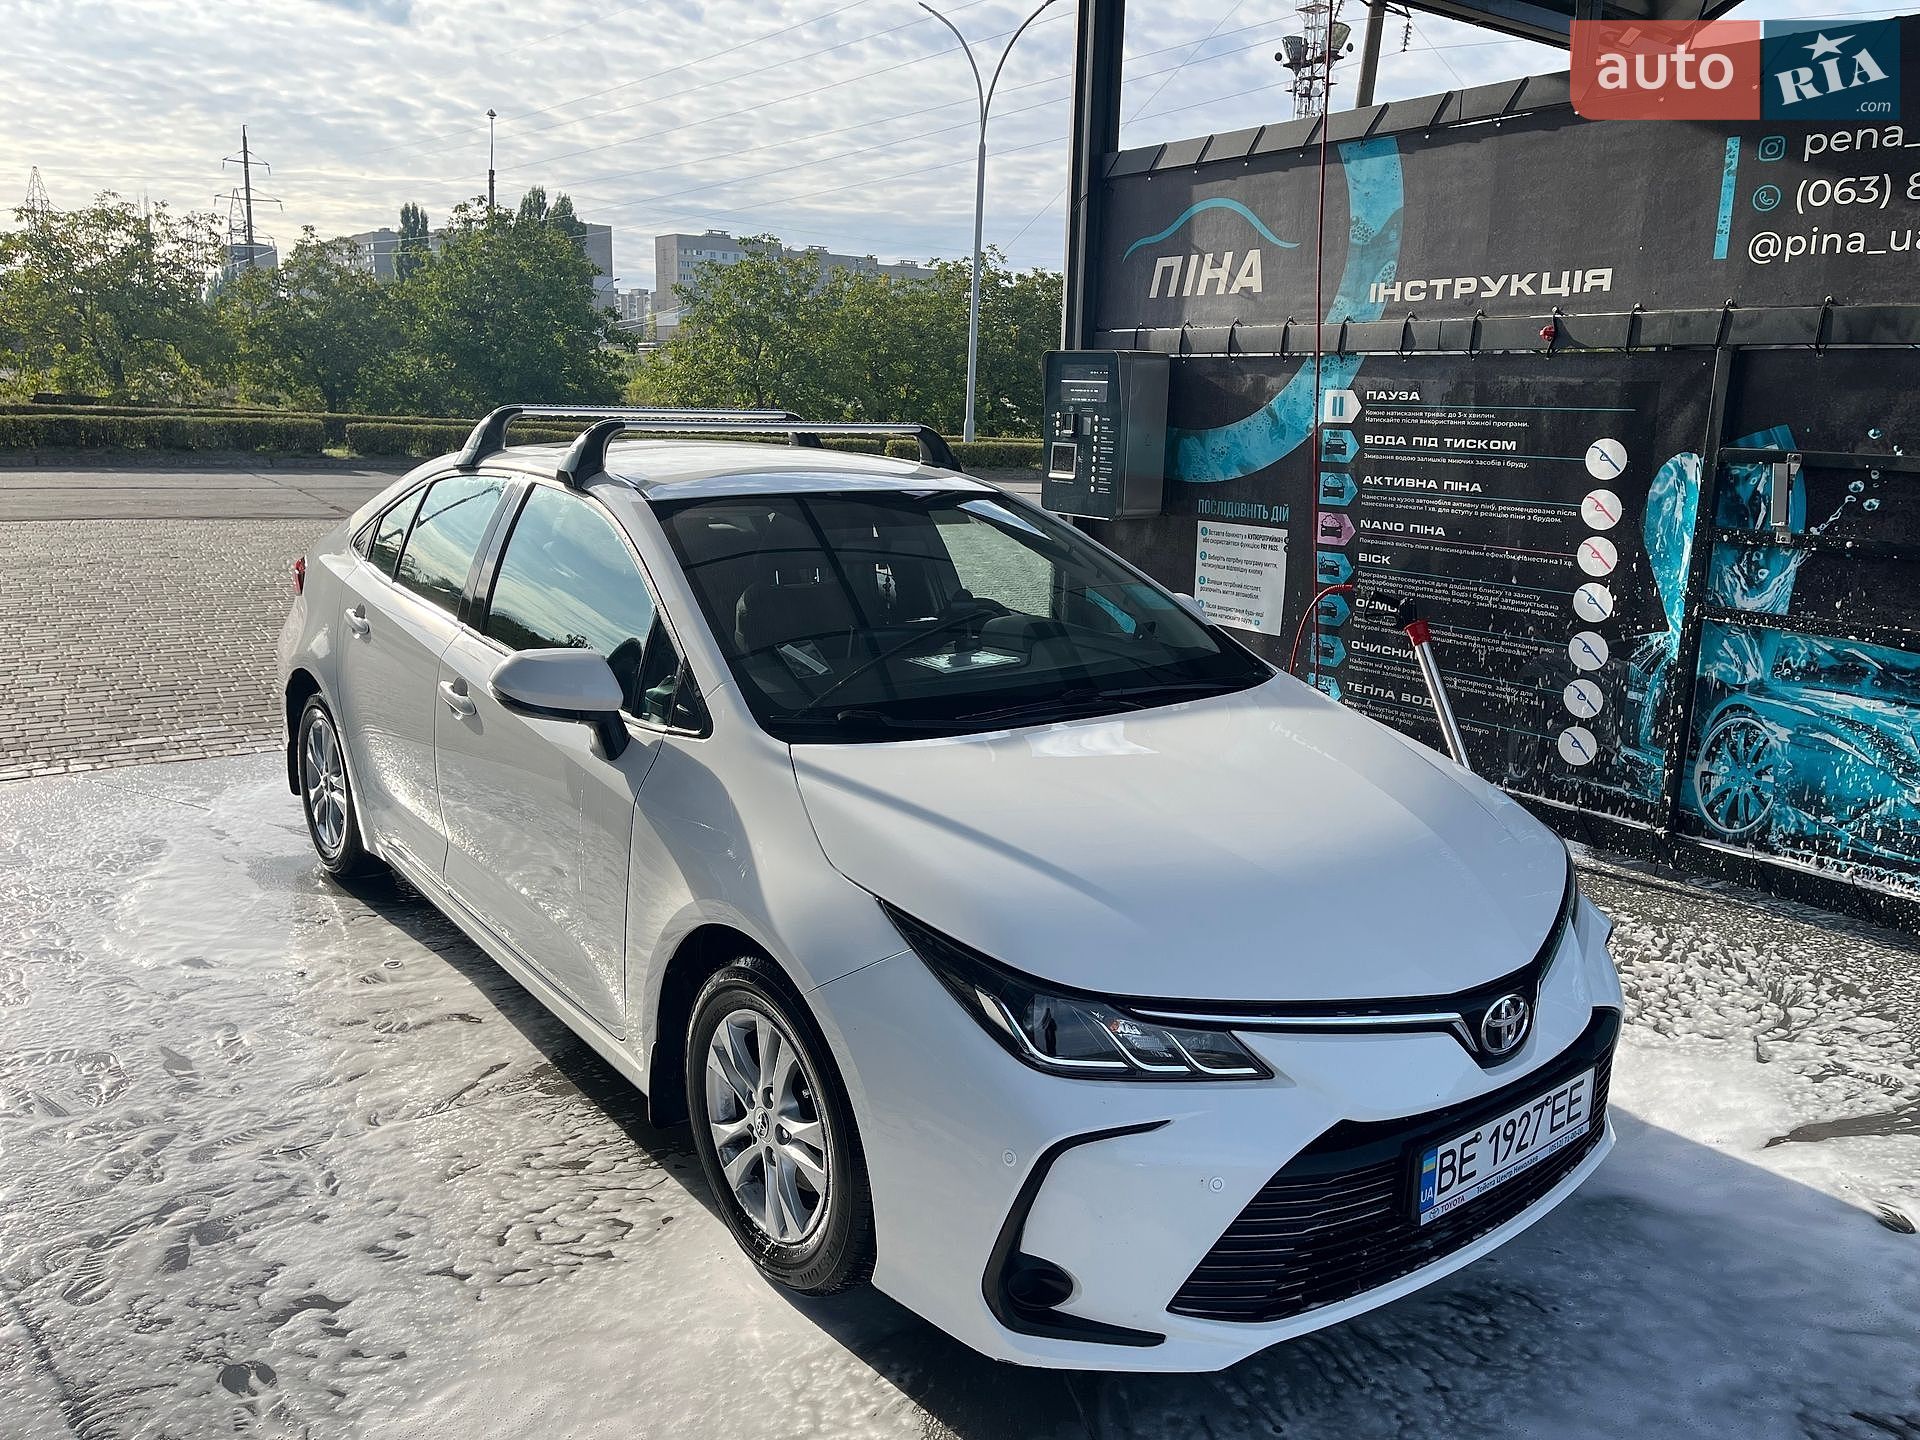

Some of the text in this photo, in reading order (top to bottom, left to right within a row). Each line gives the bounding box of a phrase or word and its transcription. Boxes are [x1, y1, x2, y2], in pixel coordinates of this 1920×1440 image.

[1796, 173, 1891, 215] (063)
[1149, 249, 1263, 299] ПІНА
[1369, 268, 1613, 303] ІНСТРУКЦІЯ
[1366, 391, 1420, 401] ПАУЗА
[1364, 434, 1517, 450] ВОДА ПІД ТИСКОМ
[1364, 452, 1394, 460] Змивання
[1506, 460, 1529, 469] бруду.
[1363, 476, 1483, 493] АКТИВНА ПІНА
[1198, 499, 1289, 522] ПОСЛІДОВНІТЬ ДІЙ
[1361, 493, 1387, 501] Нанести
[1416, 498, 1451, 506] автомобіля
[1452, 501, 1480, 509] активну
[1480, 502, 1497, 511] піну,
[1498, 505, 1556, 515] рекомендовано
[1556, 509, 1577, 517] після
[1450, 508, 1473, 516] вступу
[1480, 510, 1509, 519] реакцію
[1532, 515, 1562, 523] брудом.
[1360, 519, 1446, 537] NANO ПІНА
[1358, 553, 1391, 565] ВІСК
[1357, 570, 1388, 580] Програма
[1388, 575, 1435, 585] застосовується
[1448, 583, 1478, 591] додання
[1478, 586, 1503, 595] блиску
[1513, 592, 1541, 601] захисту
[1358, 578, 1403, 589] лакофарбового
[1404, 584, 1433, 593] покриття
[1451, 590, 1468, 598] Вода
[1472, 592, 1489, 600] бруд
[1500, 597, 1549, 608] затримується
[1397, 589, 1416, 598] Після
[1416, 593, 1451, 602] нанесення
[1452, 597, 1471, 606] воску
[1476, 601, 1498, 609] змити
[1499, 604, 1531, 613] залишки
[1464, 634, 1481, 642] вода
[1481, 637, 1499, 645] після
[1347, 682, 1435, 708] ТЕПЛА ВОД
[1437, 1079, 1585, 1196] BE 1927 EE
[1420, 1186, 1434, 1203] UA
[1440, 1195, 1465, 1213] TOYOTA
